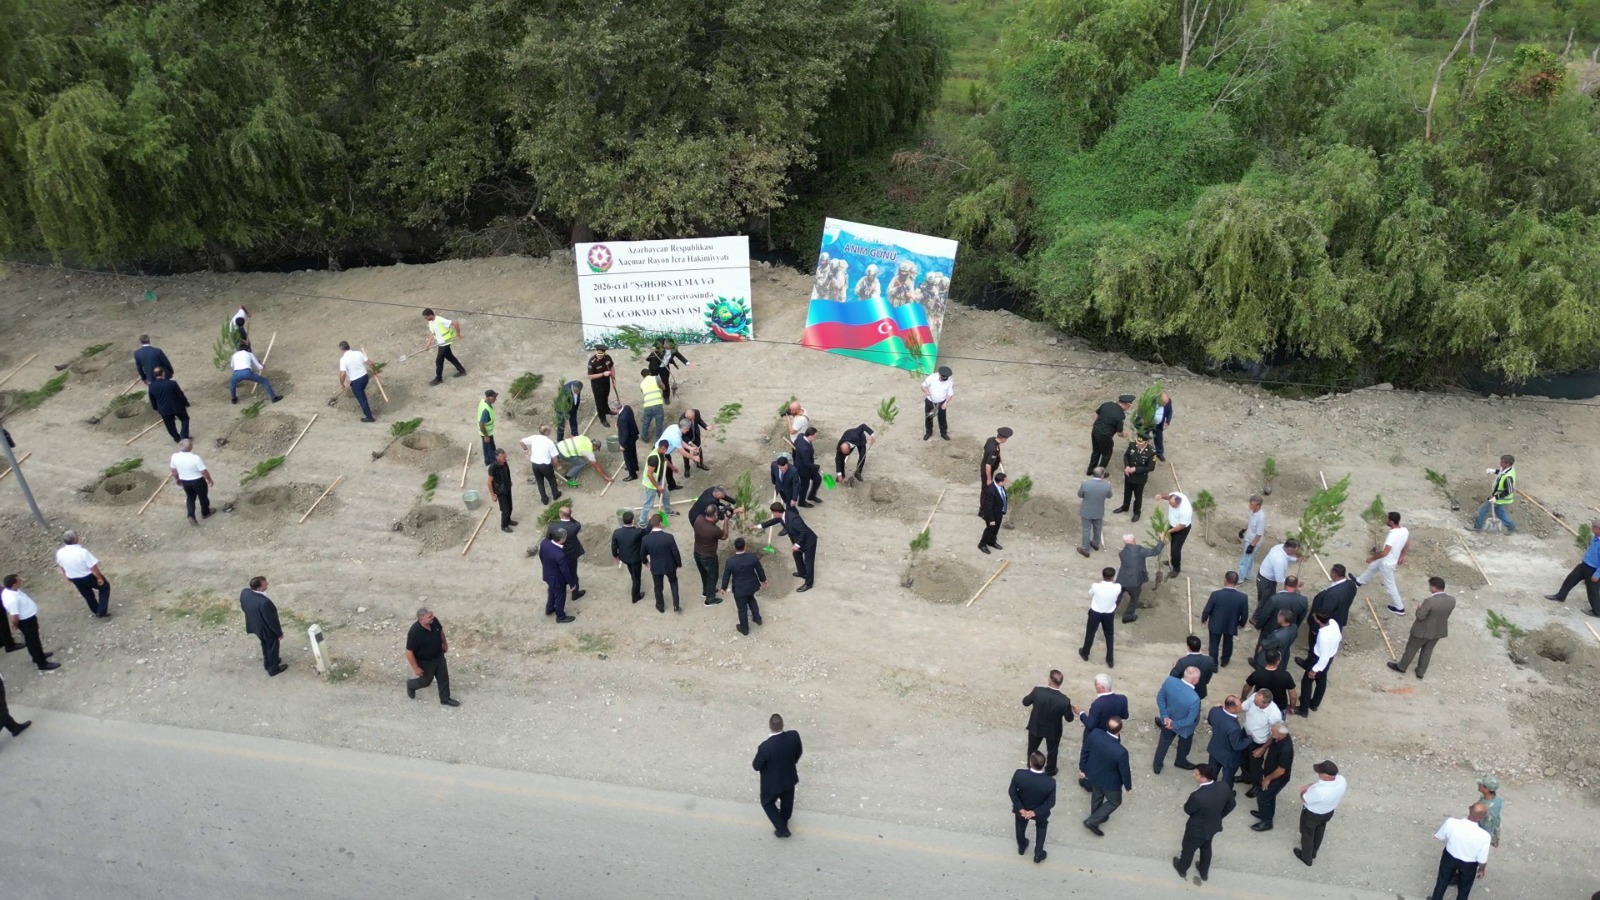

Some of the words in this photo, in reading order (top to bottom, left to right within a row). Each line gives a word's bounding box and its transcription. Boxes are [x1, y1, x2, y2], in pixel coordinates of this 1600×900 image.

[628, 246, 668, 255] Azərbaycan
[671, 243, 714, 253] Respublikası
[843, 243, 868, 256] ANIM
[618, 258, 645, 267] Xaçmaz
[647, 256, 669, 265] Rayon
[671, 254, 685, 263] İcra
[687, 252, 729, 263] Hakimiyyəti
[593, 282, 620, 291] 2026-cı
[701, 277, 714, 285] VƏ
[594, 295, 645, 304] MEMARLIQ
[667, 291, 713, 302] çərçivəsində
[659, 306, 701, 315] AKSİYASI
